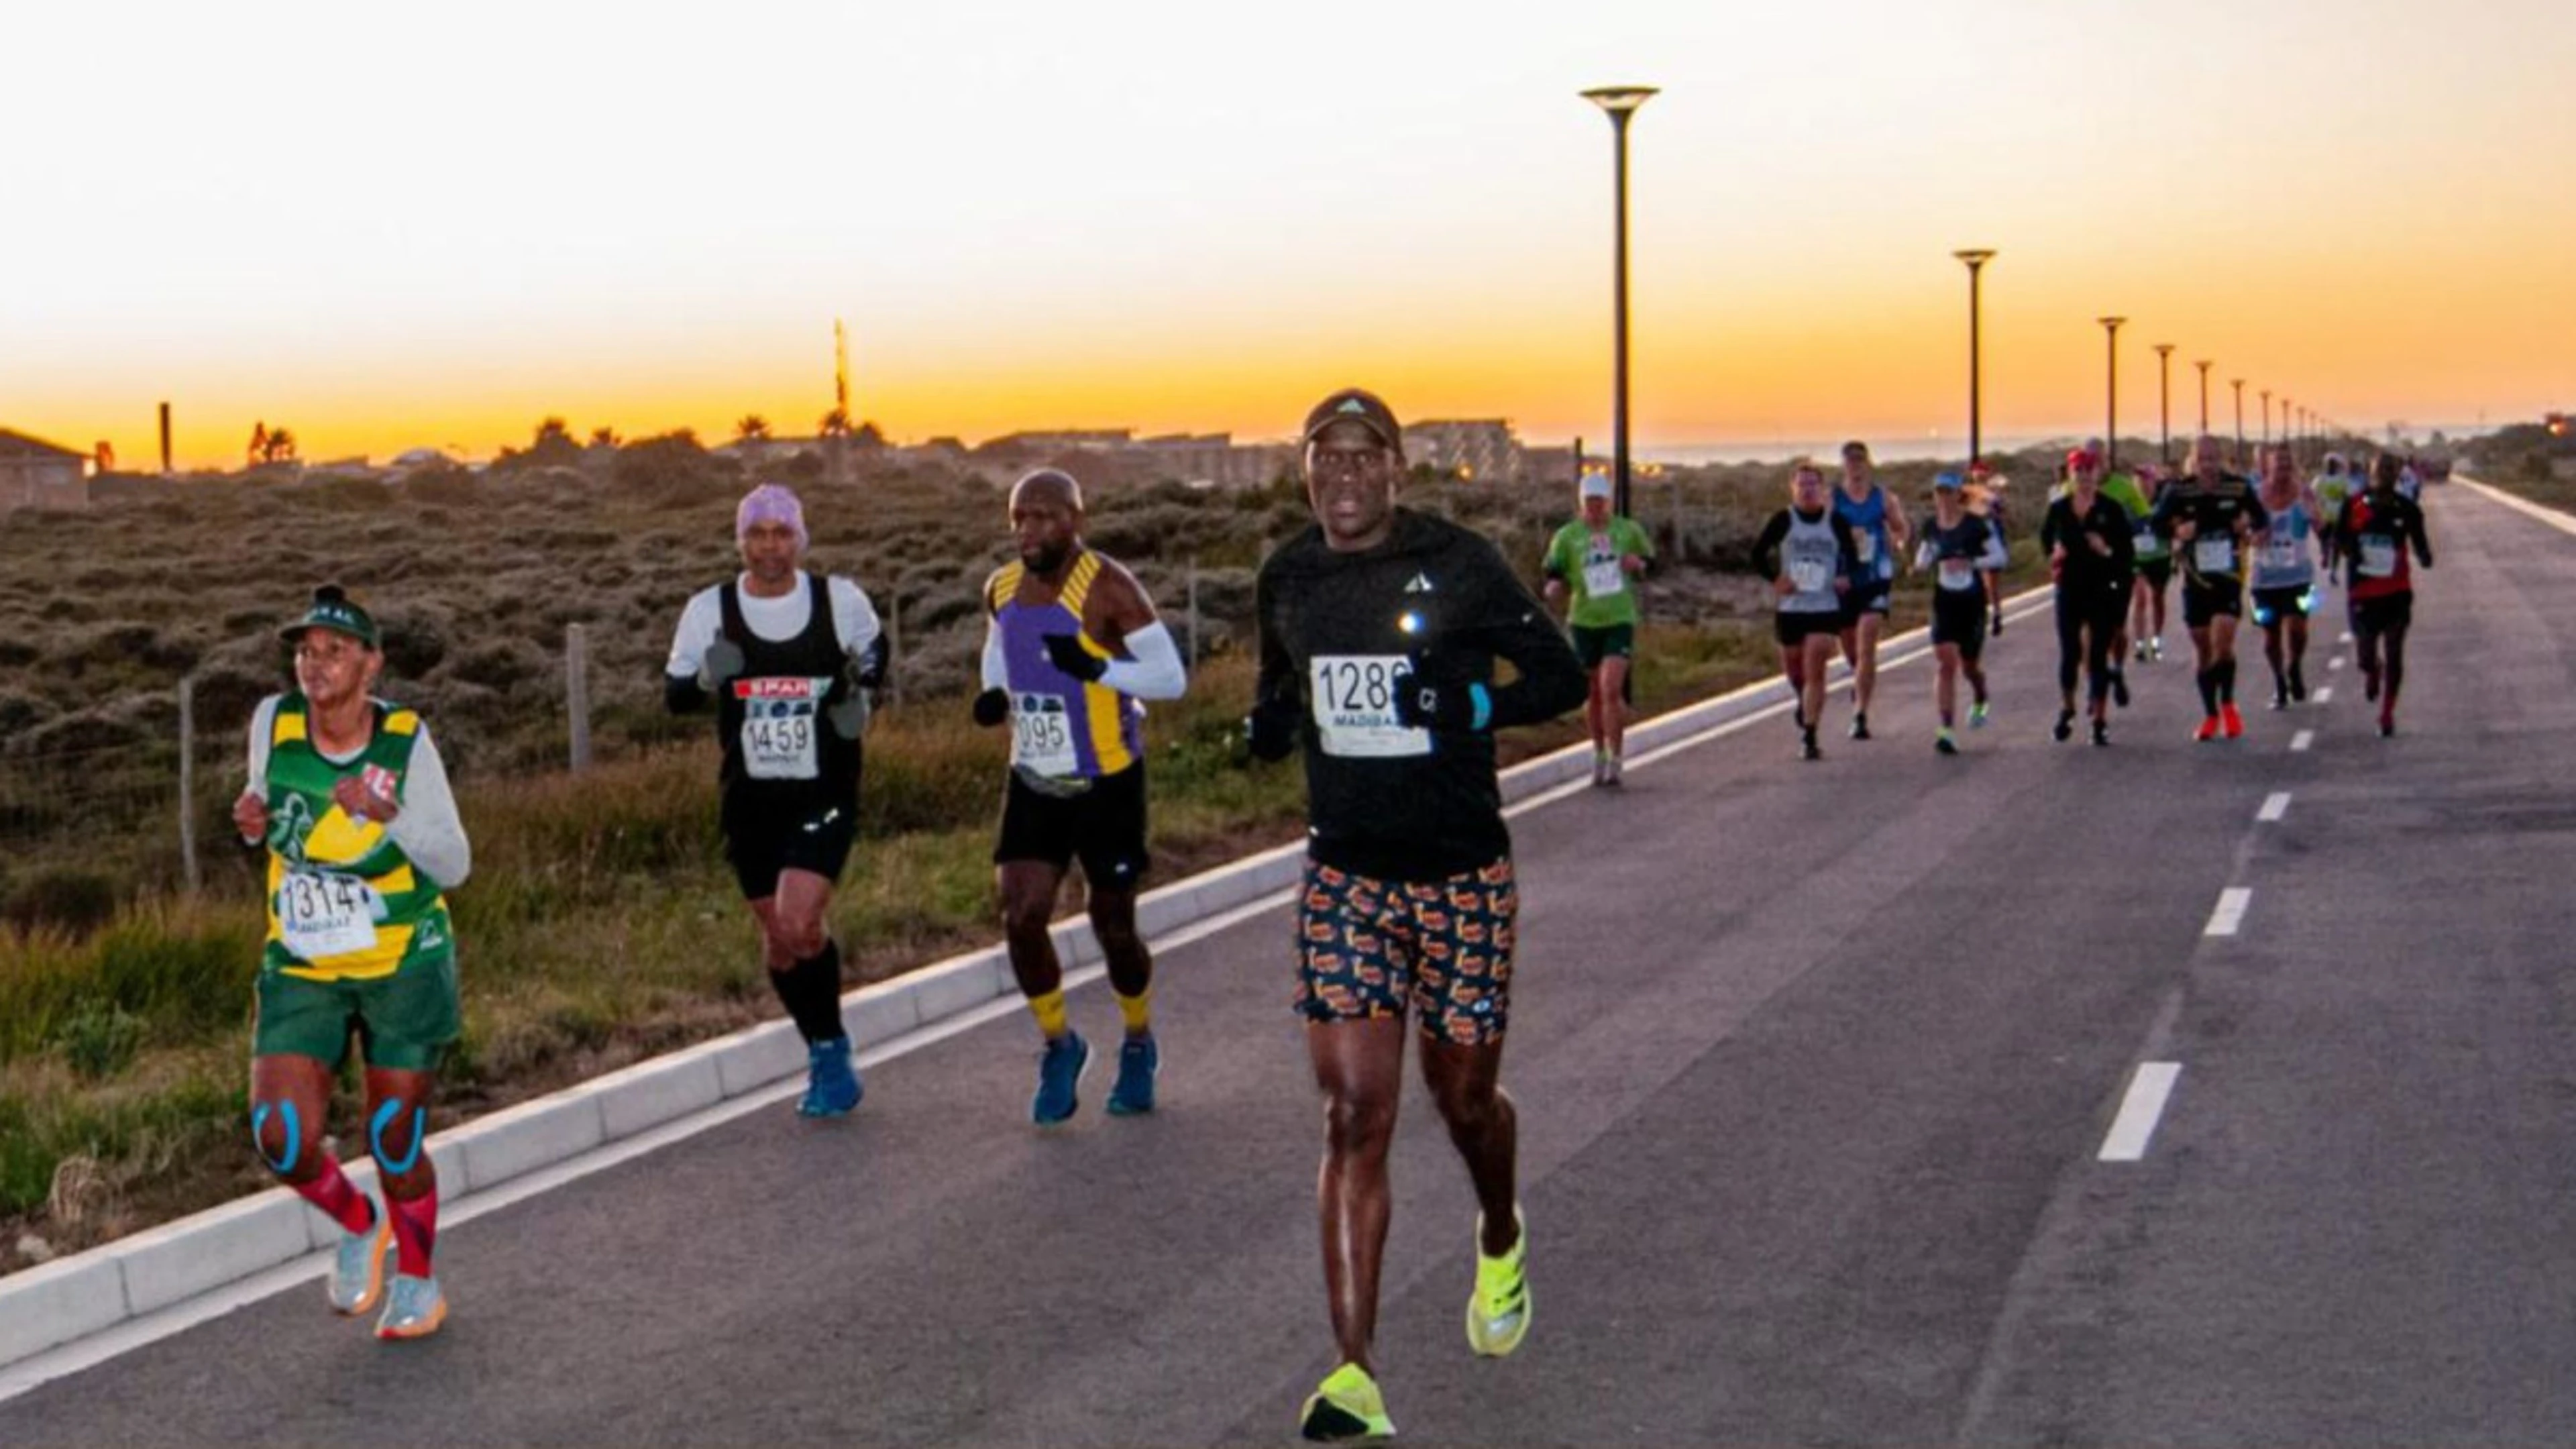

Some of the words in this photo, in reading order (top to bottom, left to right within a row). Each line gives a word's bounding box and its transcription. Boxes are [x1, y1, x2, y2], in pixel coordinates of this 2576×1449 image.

[1320, 661, 1409, 710] 128
[748, 718, 808, 752] 1459
[1018, 714, 1065, 749] 095
[1334, 714, 1398, 727] MADIBA
[285, 876, 357, 922] 1314
